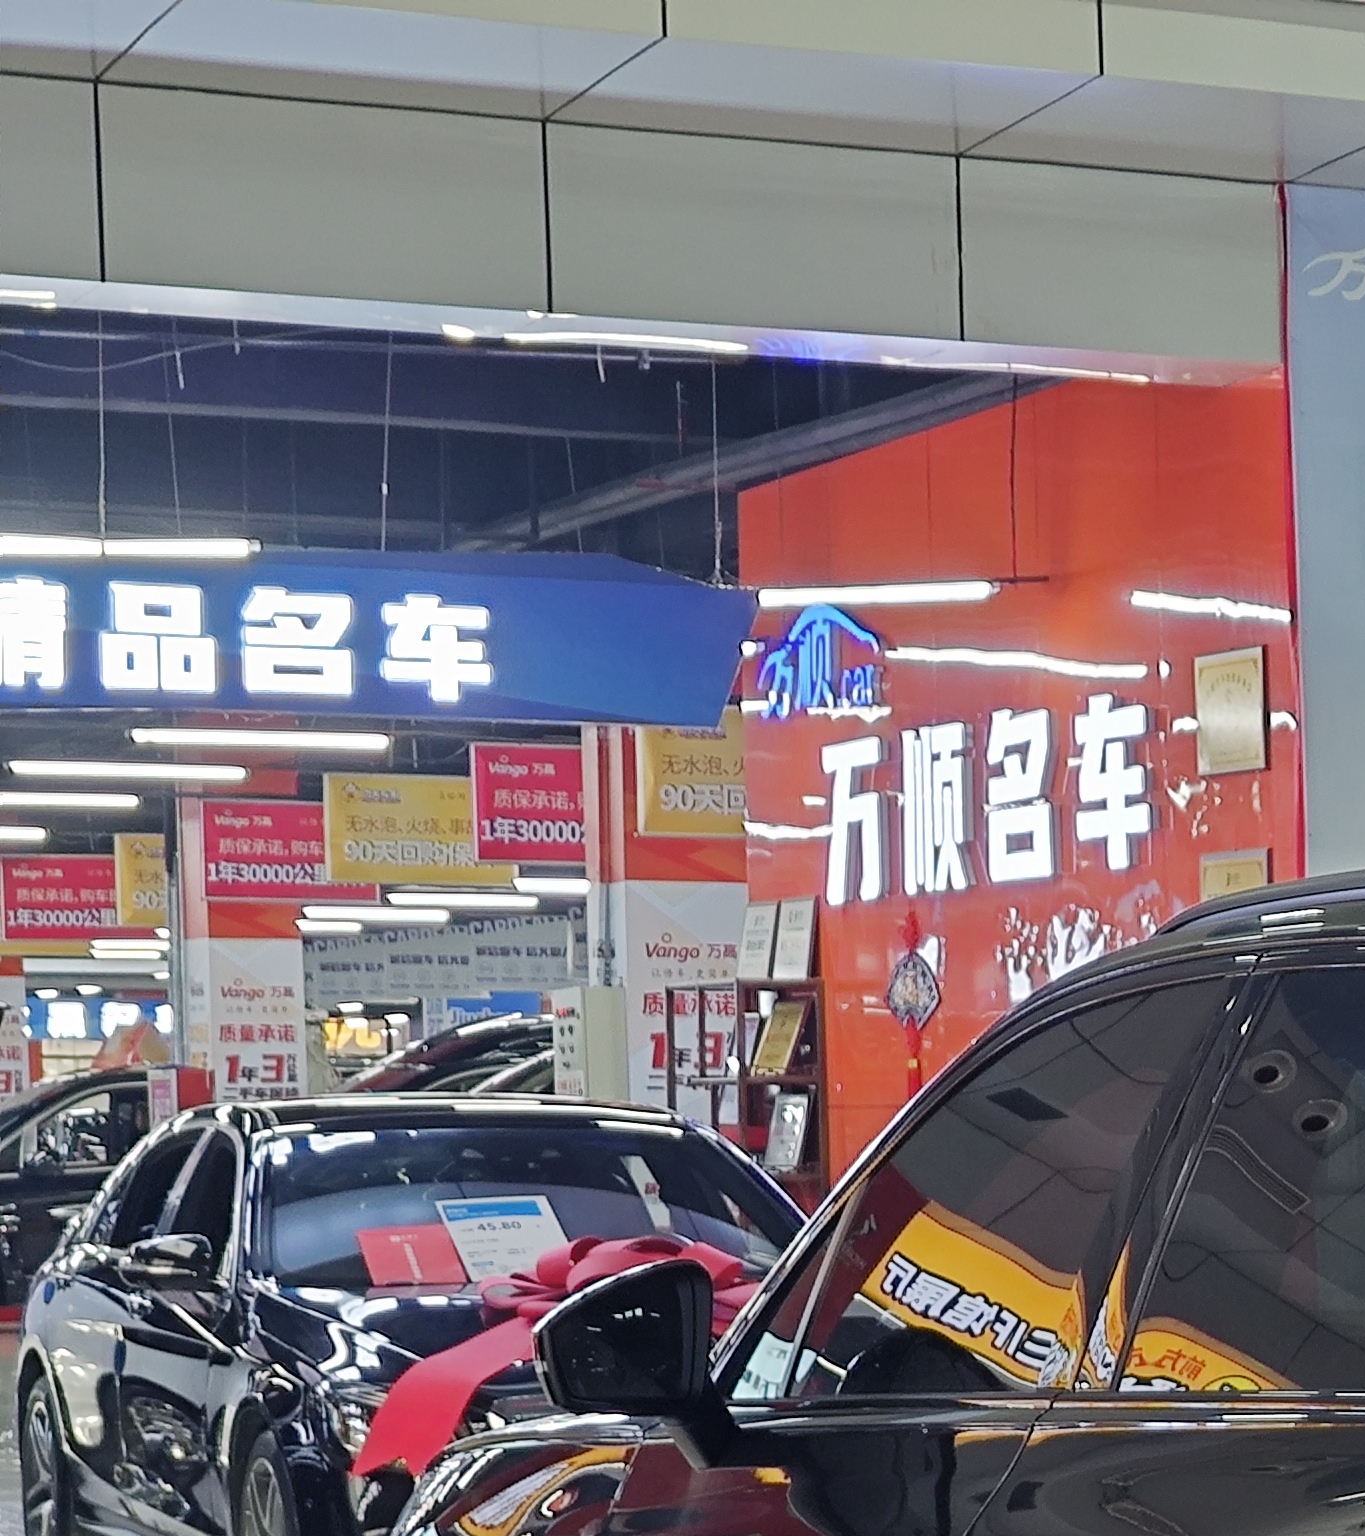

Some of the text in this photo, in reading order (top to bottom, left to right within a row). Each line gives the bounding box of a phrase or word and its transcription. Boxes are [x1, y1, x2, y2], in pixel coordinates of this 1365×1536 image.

[821, 693, 1152, 905] 万顺名车
[645, 941, 700, 963] Vango
